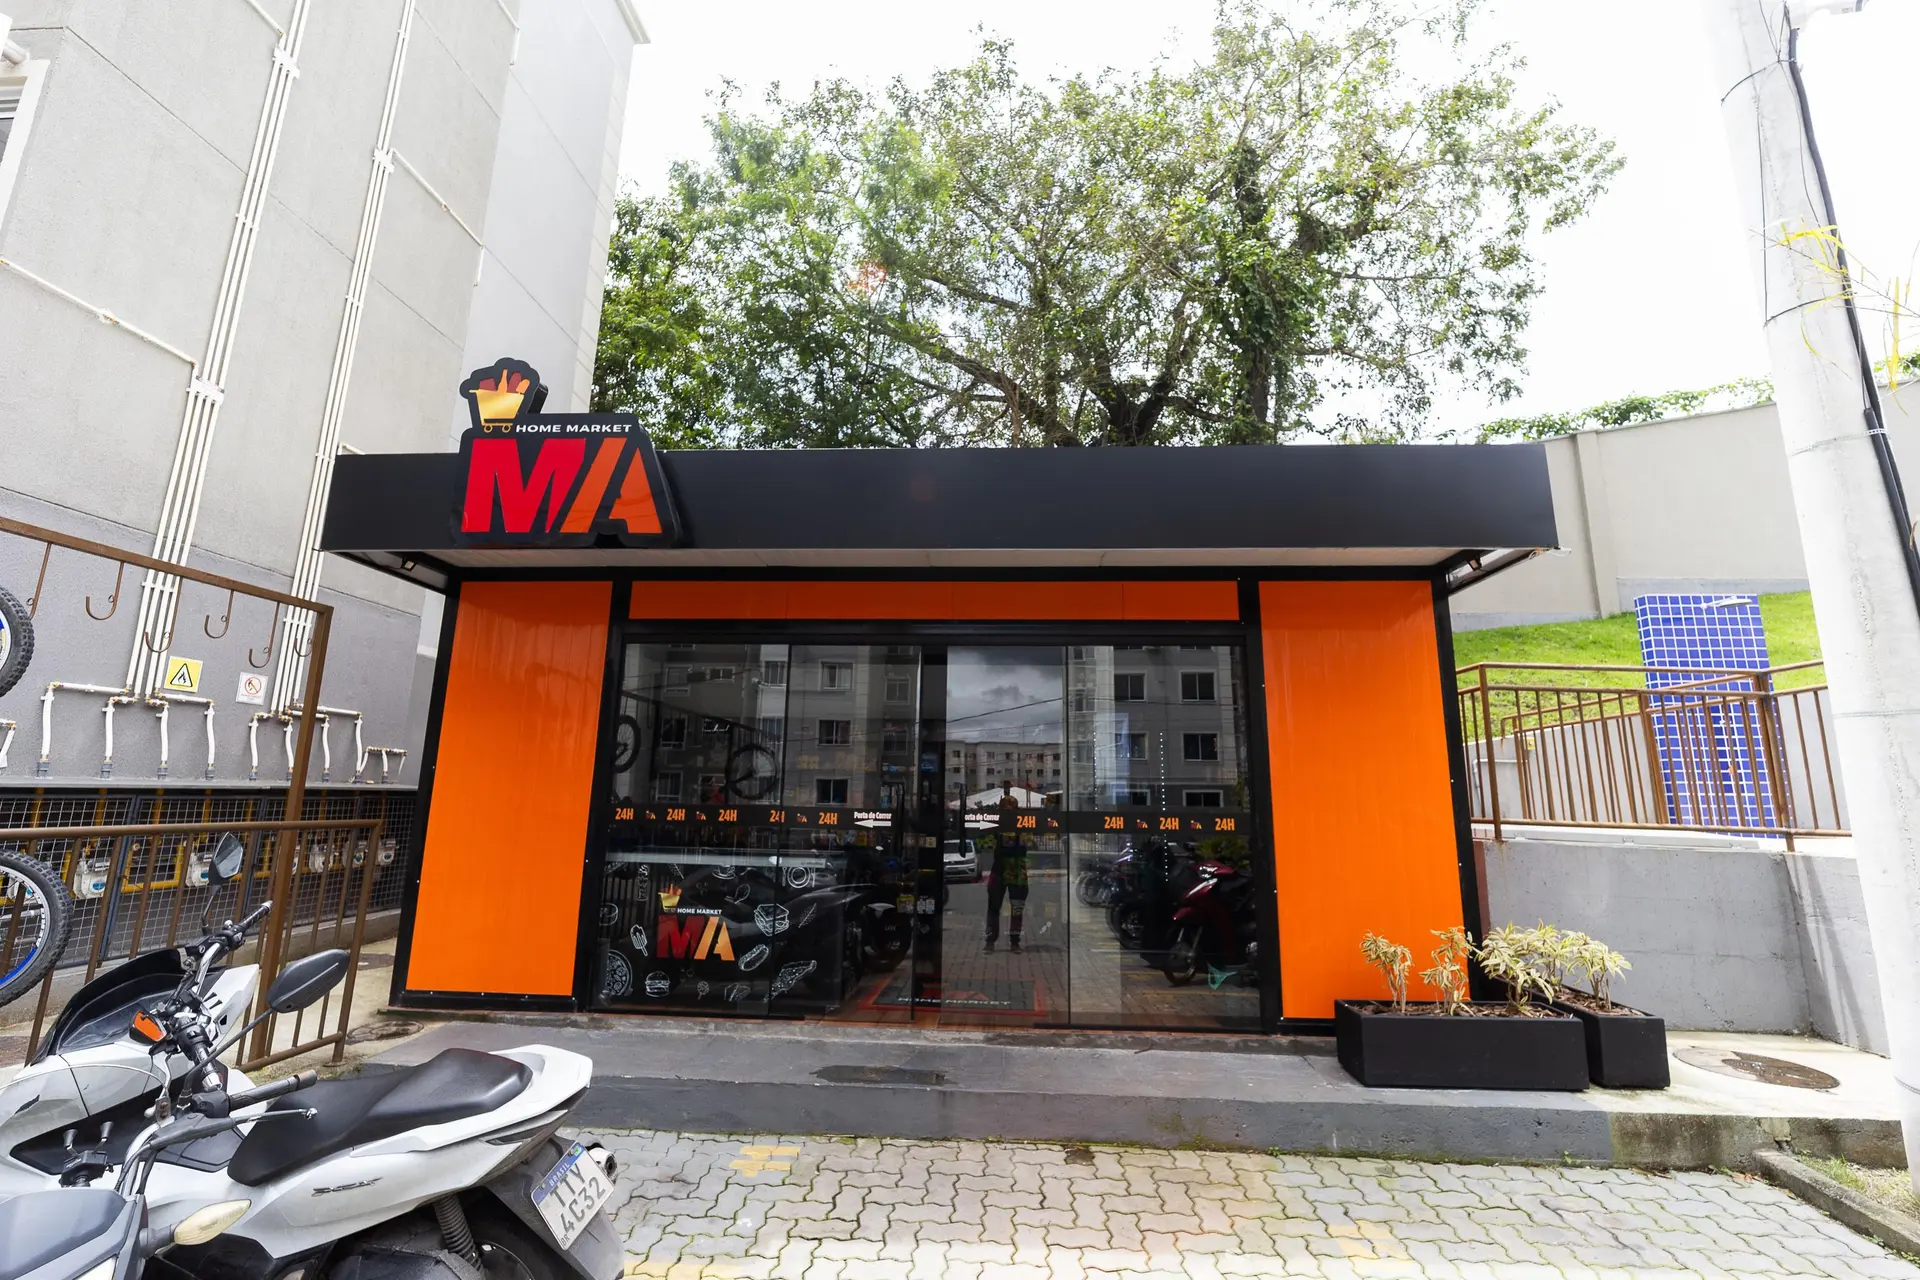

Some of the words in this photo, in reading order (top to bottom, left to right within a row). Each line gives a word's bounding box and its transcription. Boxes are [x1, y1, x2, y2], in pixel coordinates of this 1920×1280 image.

[515, 424, 561, 433] HOME
[566, 424, 632, 433] MARKET
[615, 807, 634, 820] 24H
[667, 808, 686, 821] 24H
[718, 809, 738, 822] 24H
[818, 812, 838, 825] 24H
[853, 811, 868, 819] Porta
[868, 811, 875, 819] de
[875, 811, 892, 820] Correr
[964, 813, 975, 821] orta
[976, 813, 983, 821] de
[983, 813, 1000, 821] Correr
[1016, 815, 1036, 829] 24H
[1104, 816, 1124, 829] 24H
[1159, 817, 1180, 830] 24H
[1215, 818, 1235, 831] 24H
[548, 1163, 571, 1187] BRASIL
[550, 1163, 586, 1208] TTY
[560, 1176, 606, 1234] 4C32
